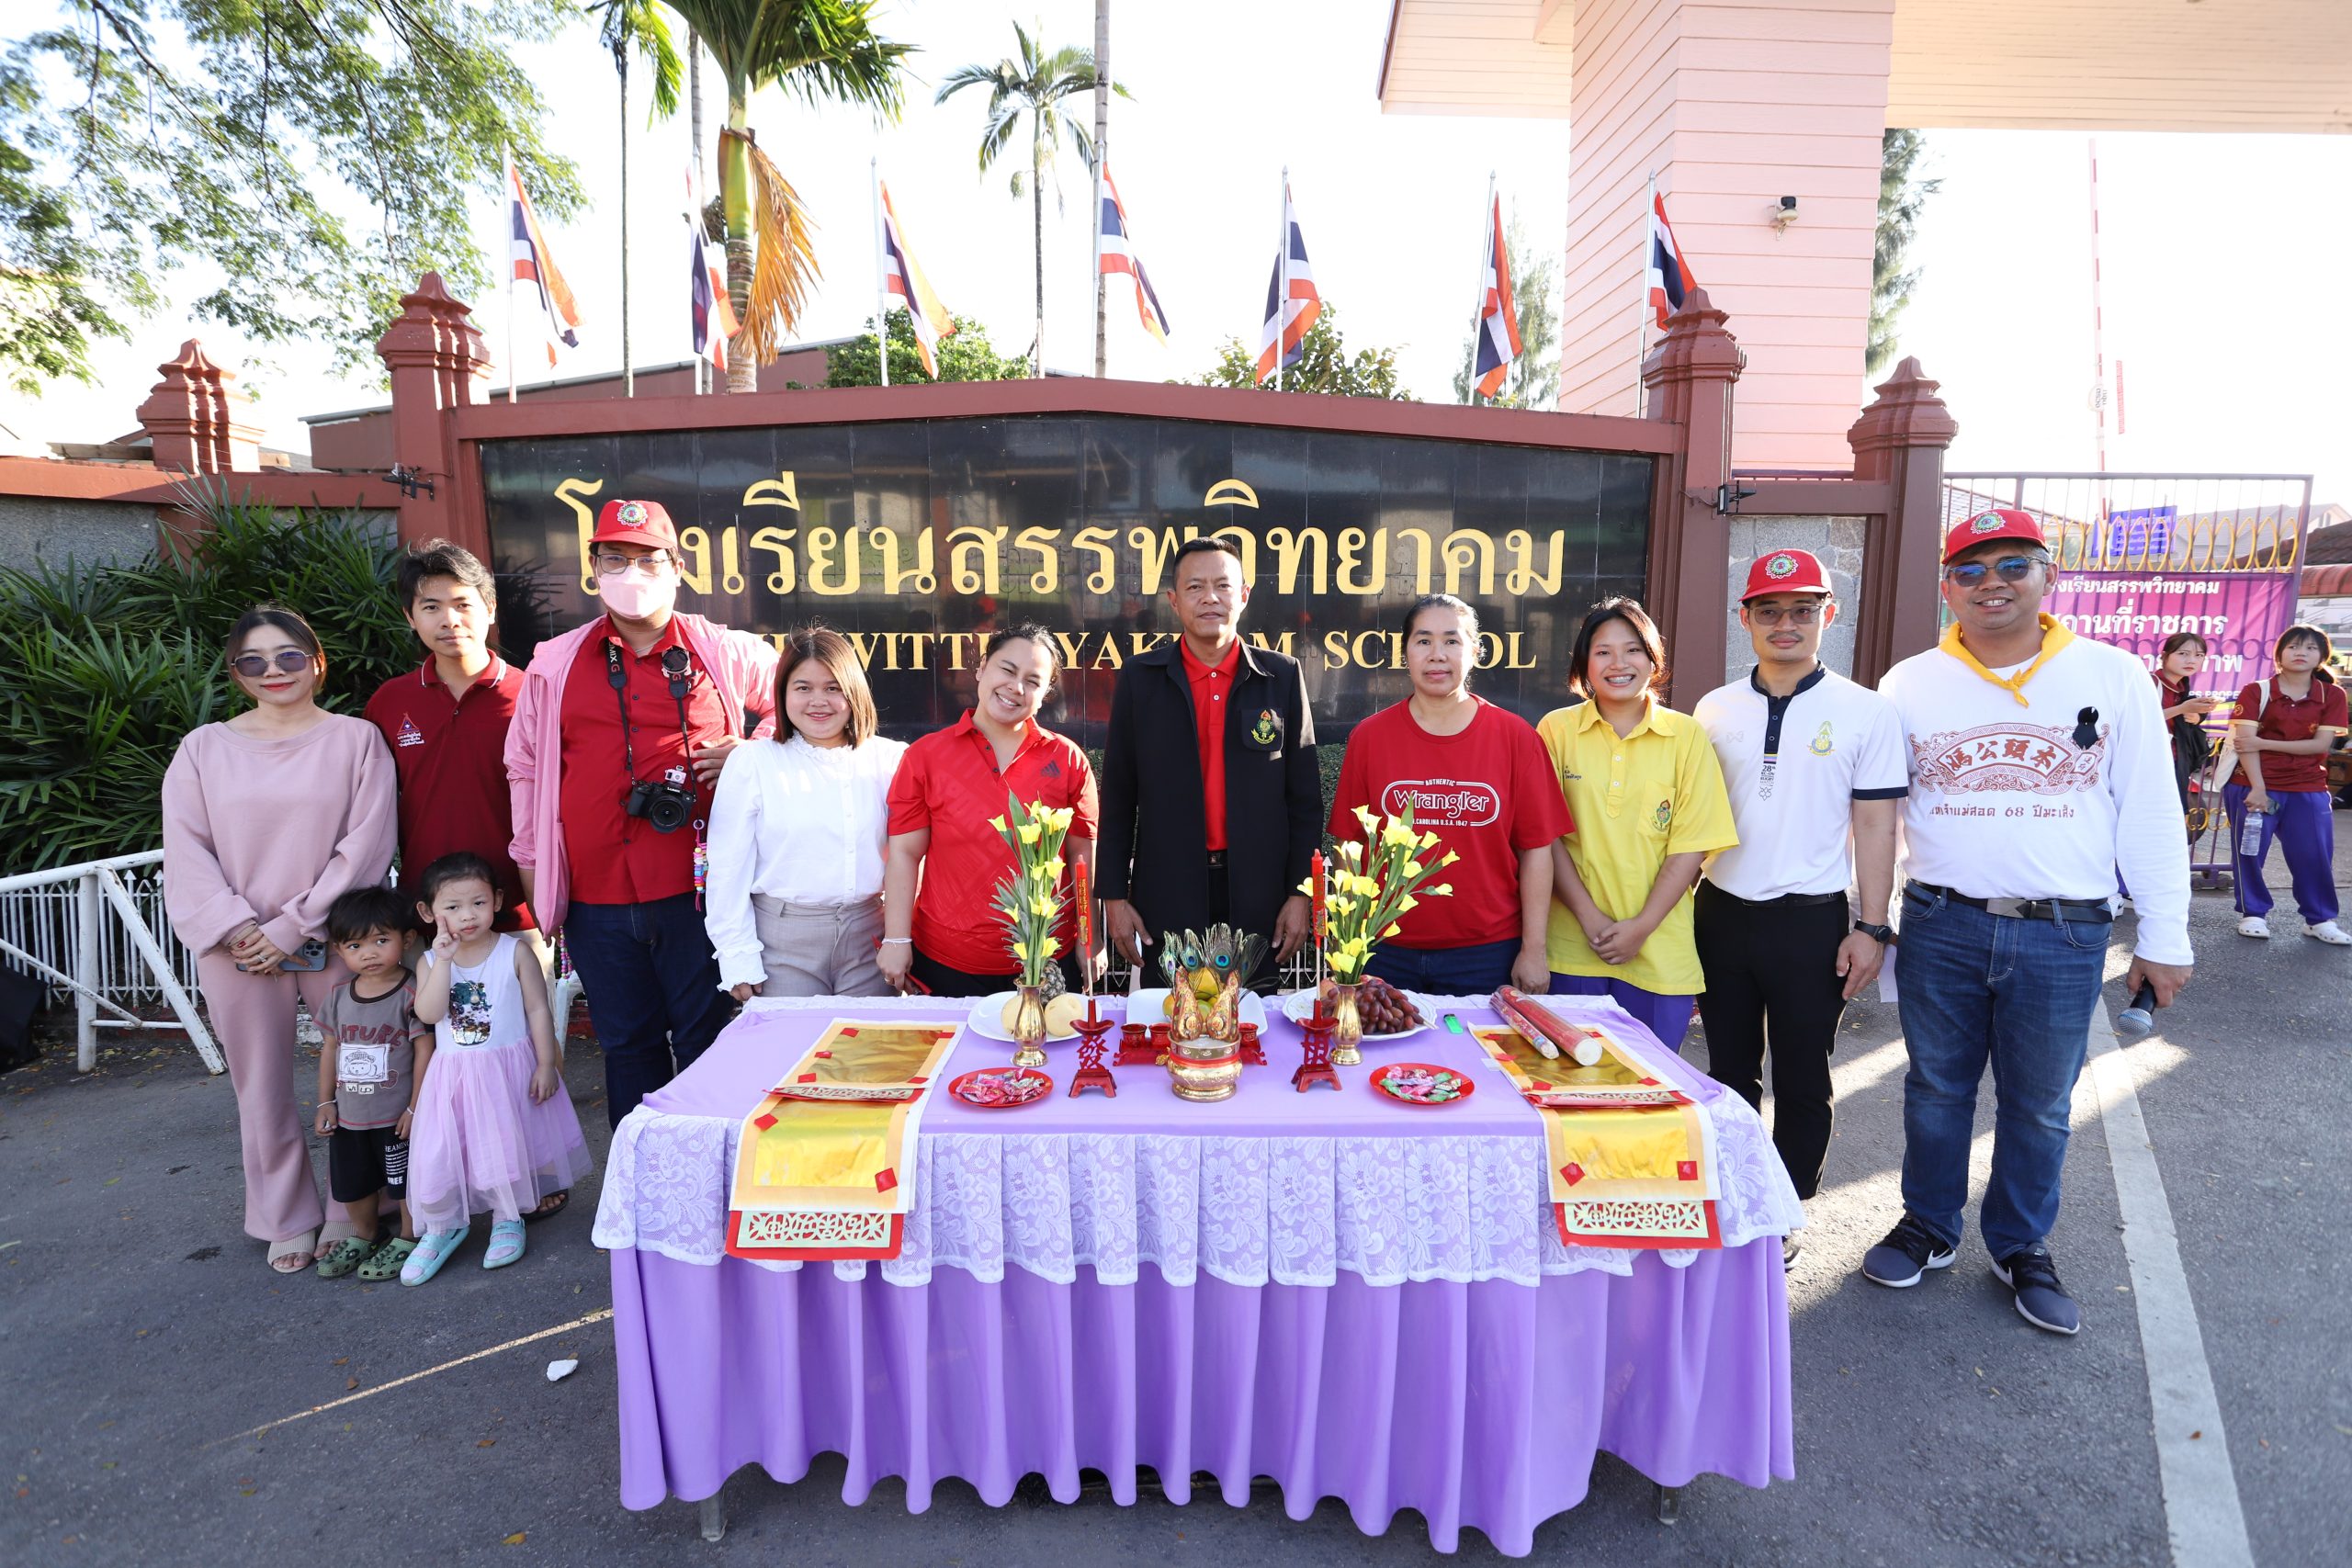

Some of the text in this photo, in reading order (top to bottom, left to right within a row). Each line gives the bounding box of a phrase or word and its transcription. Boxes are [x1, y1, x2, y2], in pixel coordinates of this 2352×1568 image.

[1324, 628, 1537, 671] SCOL
[1425, 778, 1456, 787] AUTHENTIC
[1393, 790, 1489, 818] Wrangler
[2005, 807, 2024, 818] 68
